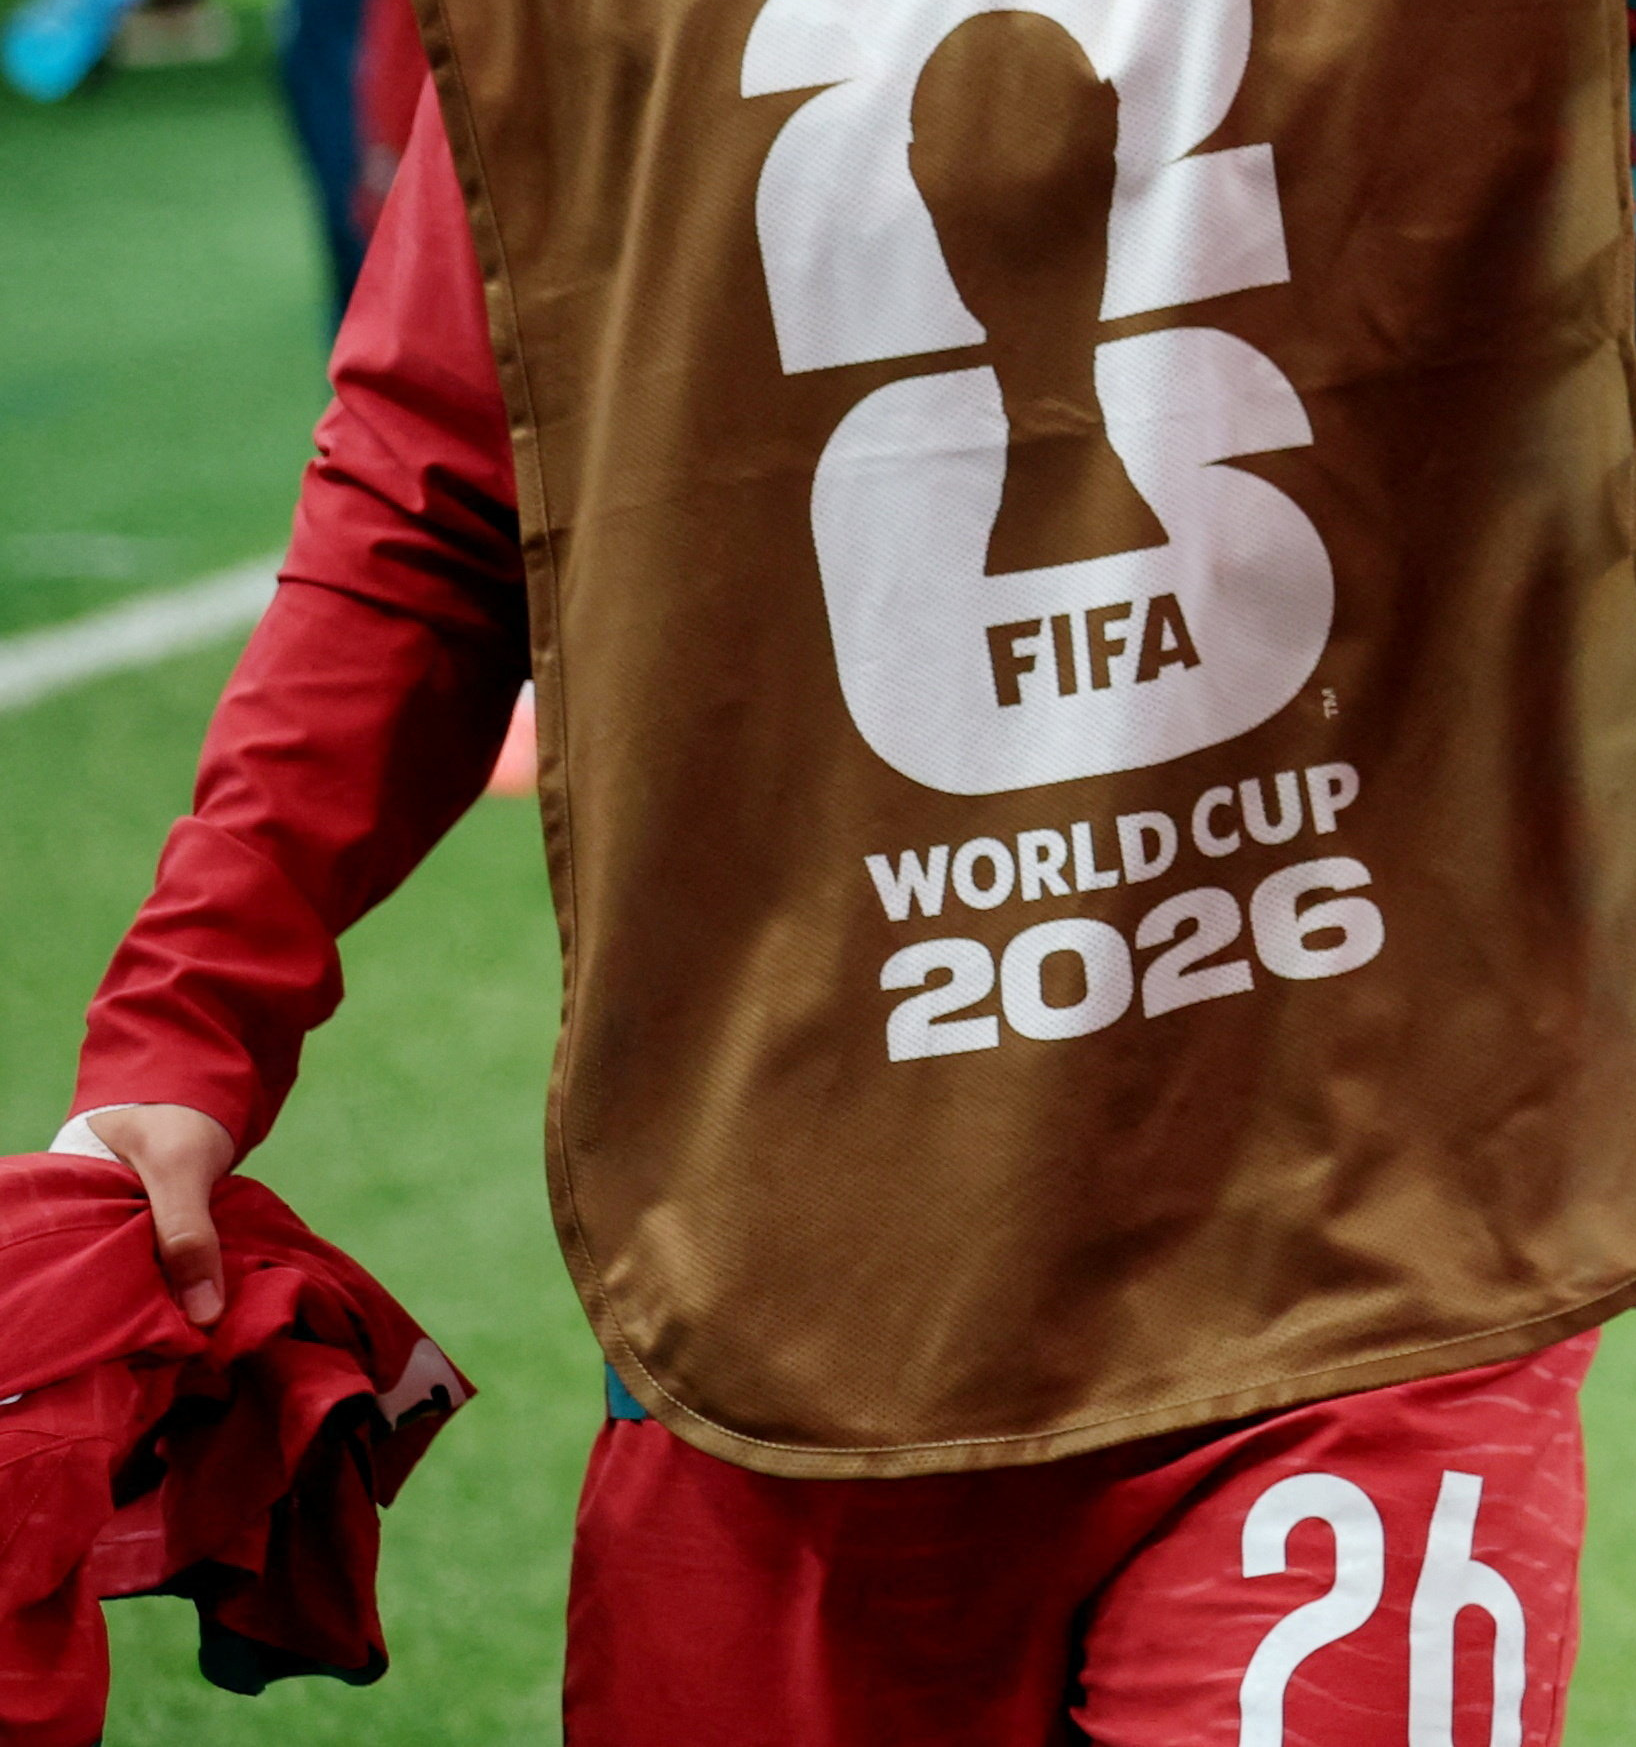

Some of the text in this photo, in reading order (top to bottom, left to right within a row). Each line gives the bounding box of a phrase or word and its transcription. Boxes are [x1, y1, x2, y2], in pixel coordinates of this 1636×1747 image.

[985, 592, 1202, 708] FIFA
[864, 761, 1360, 923] WORLD CUP
[879, 855, 1386, 1063] 2026
[1238, 1468, 1527, 1747] 26
